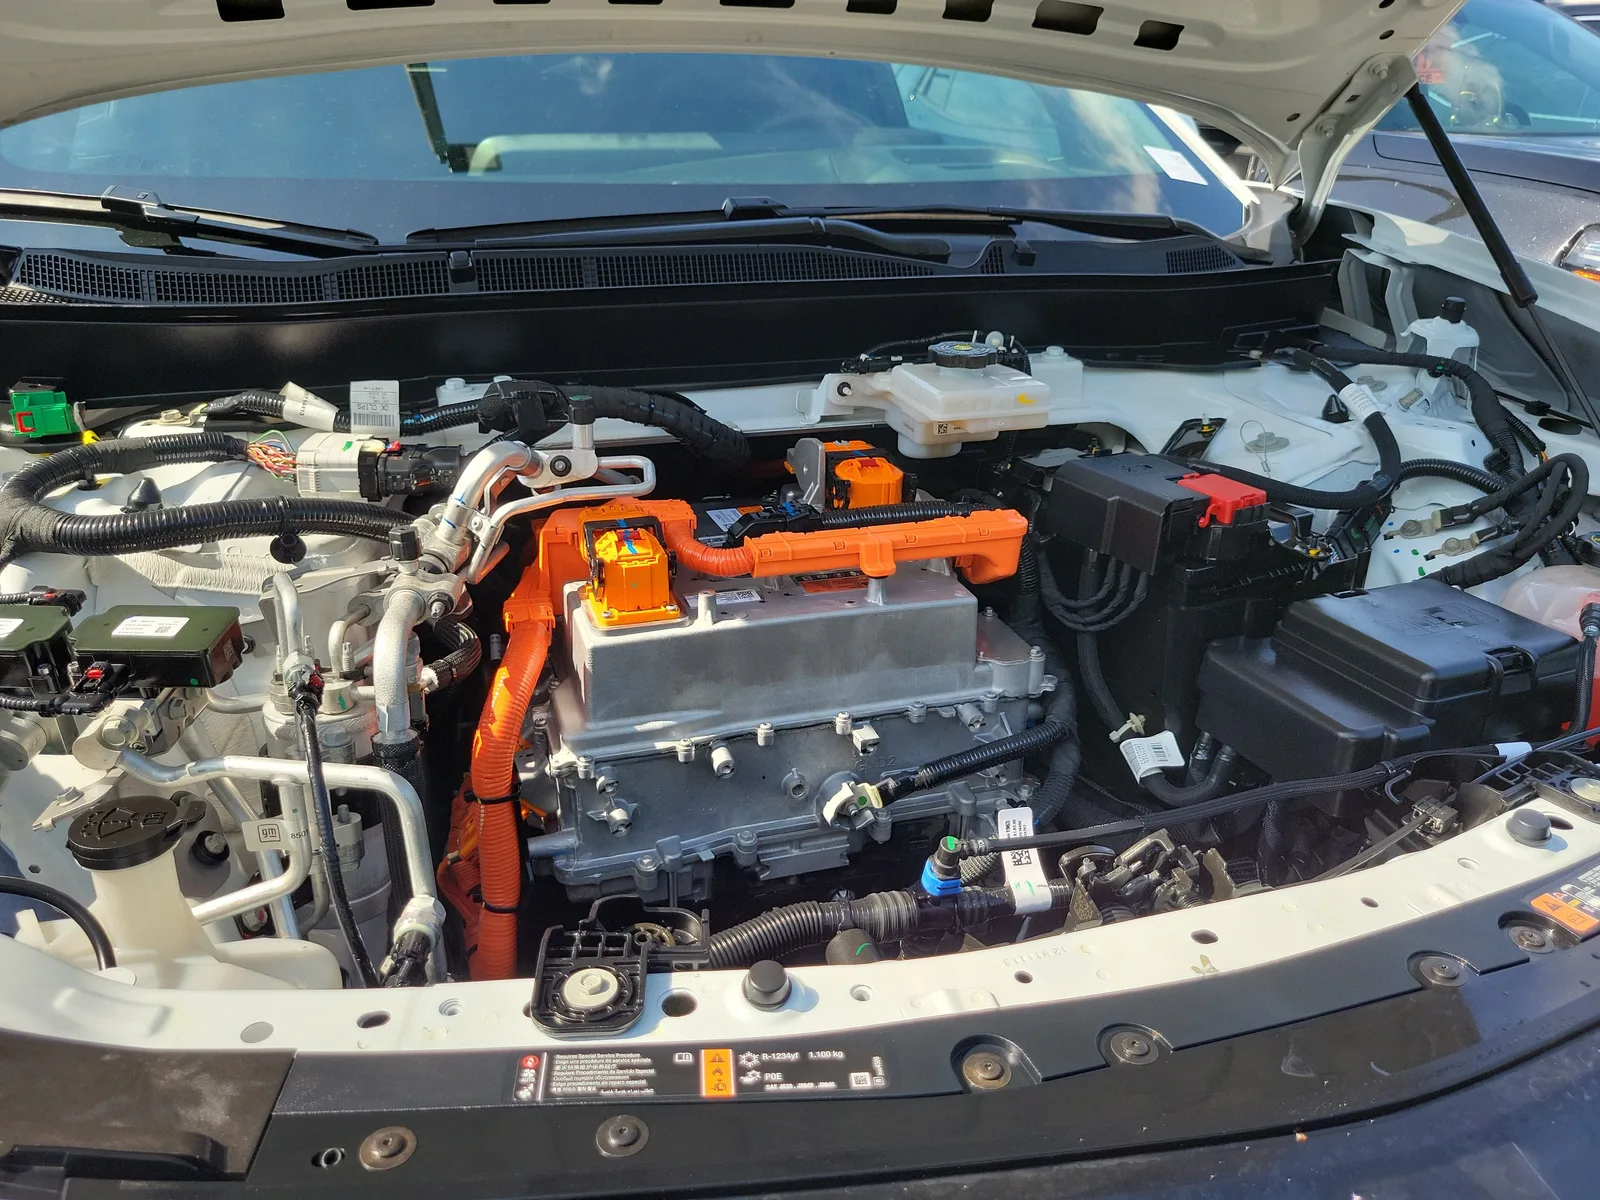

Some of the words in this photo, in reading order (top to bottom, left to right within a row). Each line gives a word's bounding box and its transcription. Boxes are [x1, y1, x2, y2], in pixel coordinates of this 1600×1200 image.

[357, 403, 377, 411] CLIPS
[262, 828, 277, 839] gm
[762, 1051, 799, 1060] R-1234yf
[832, 1050, 844, 1058] kg
[765, 1072, 783, 1080] POE
